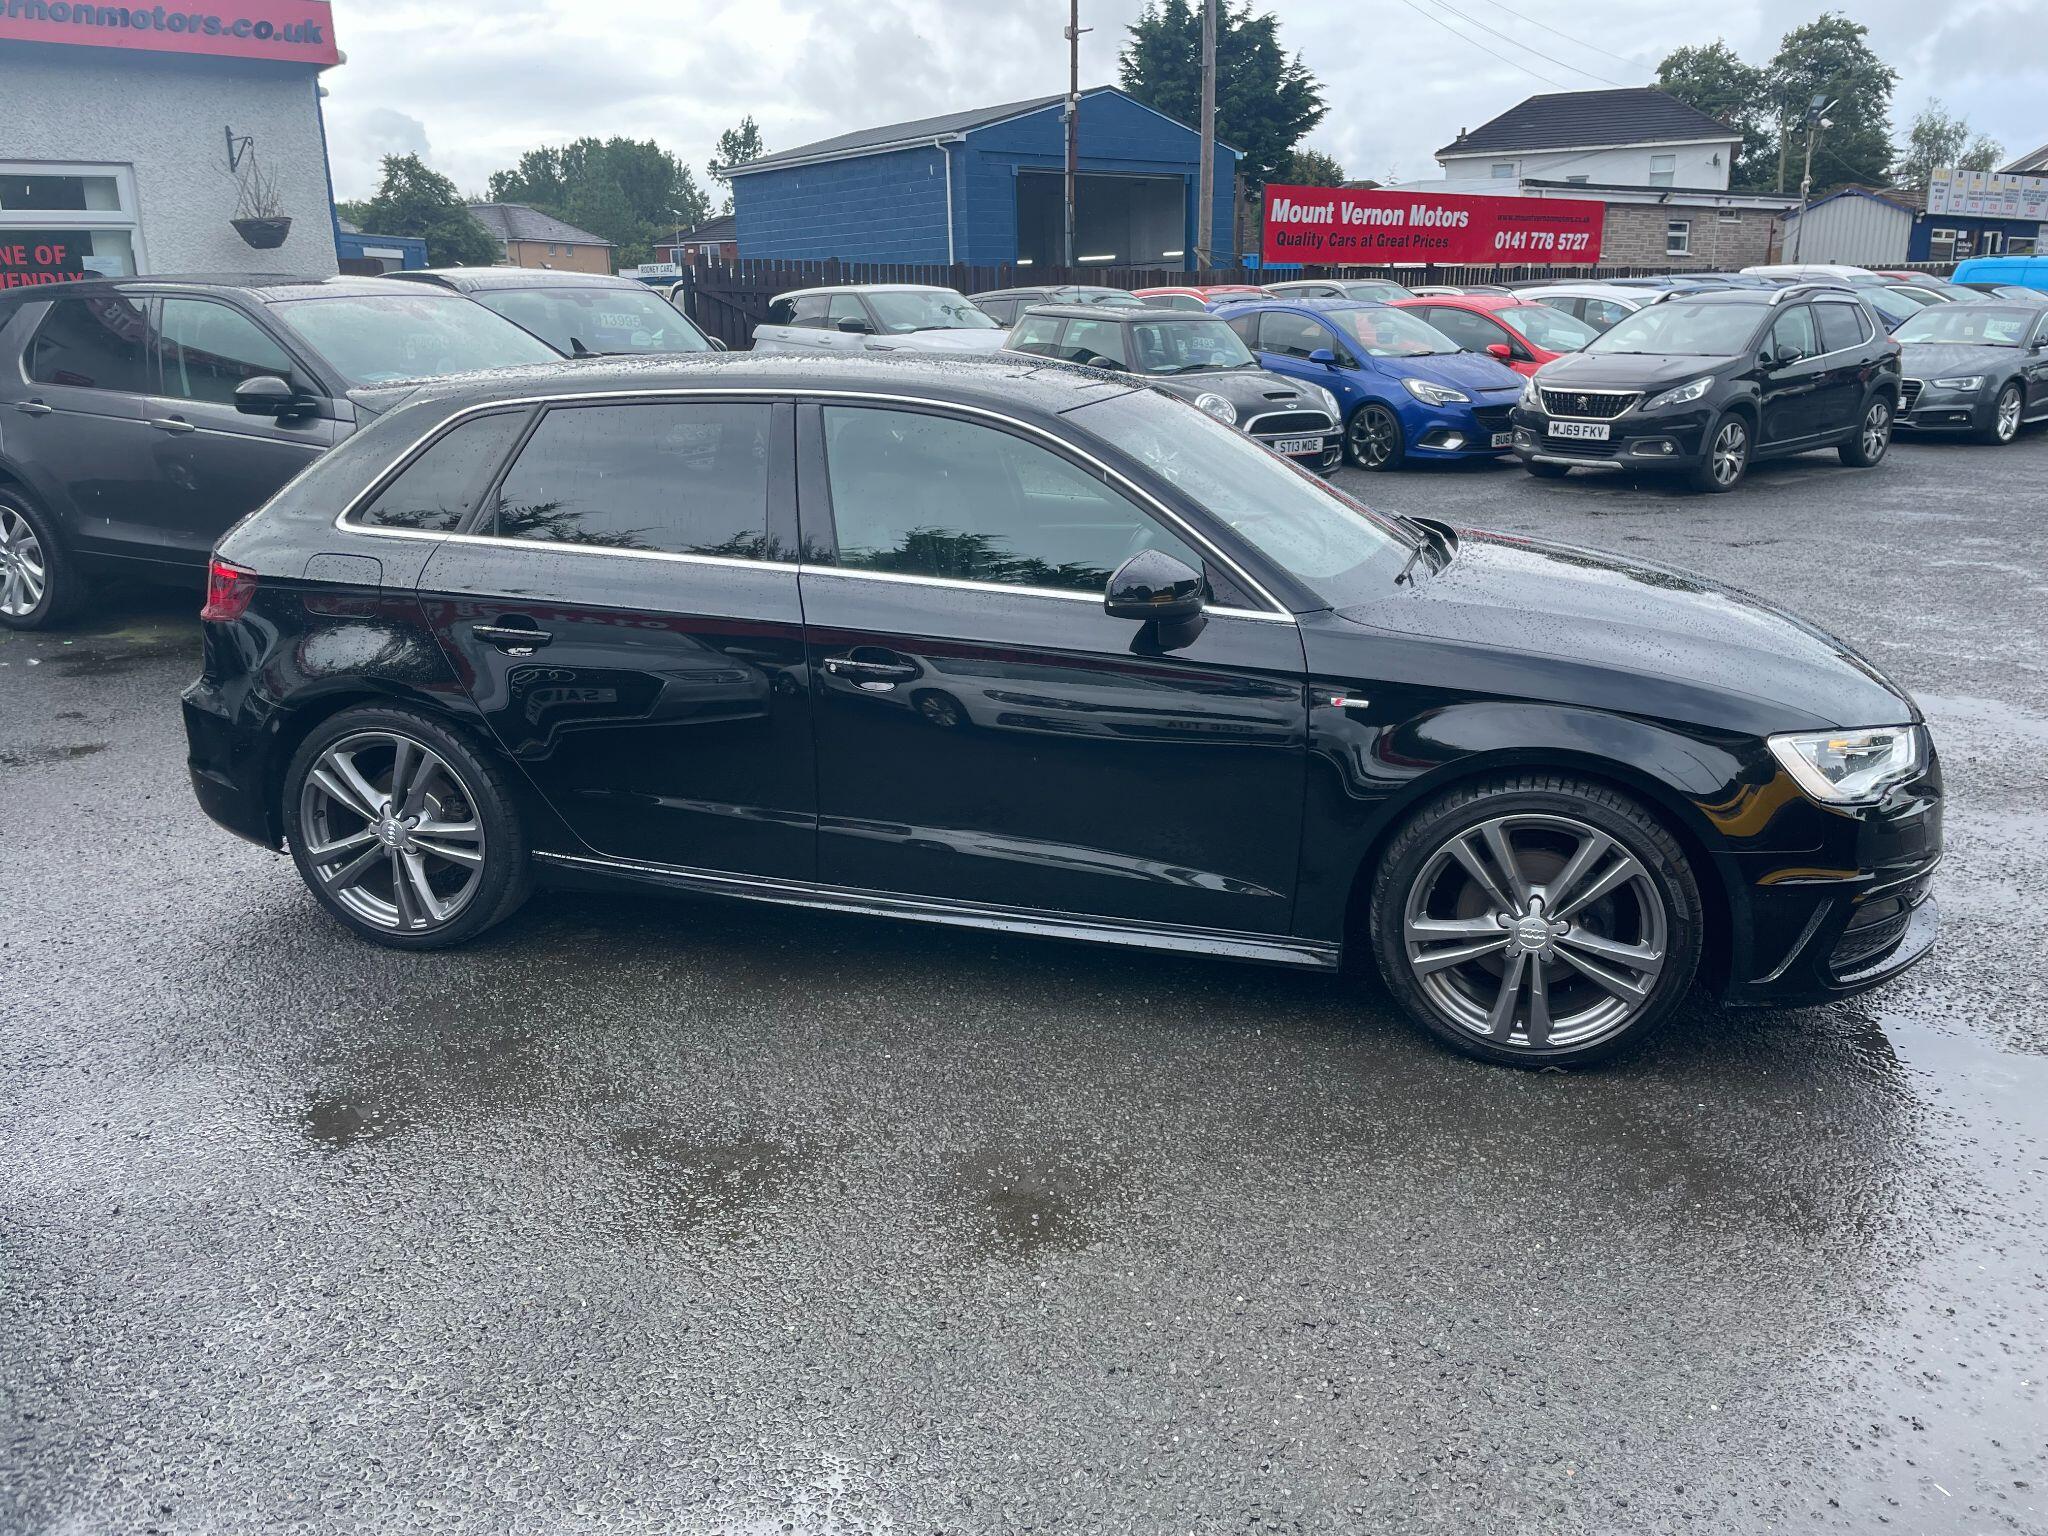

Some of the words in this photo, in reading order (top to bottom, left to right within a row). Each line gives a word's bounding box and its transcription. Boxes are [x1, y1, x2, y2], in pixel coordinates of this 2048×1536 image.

[0, 0, 324, 44] rnonmotors.co.uk
[1271, 198, 1334, 224] Mount
[1341, 201, 1404, 226] Vernon
[1409, 204, 1470, 228] Motors
[1276, 230, 1325, 250] Quality
[1328, 232, 1357, 248] Cars
[1360, 233, 1374, 248] at
[1376, 233, 1409, 248] Great
[1412, 234, 1449, 248] Prices
[1494, 231, 1527, 249] 0141
[1530, 231, 1555, 250] 778
[1557, 233, 1590, 250] 5727
[34, 245, 66, 265] OF
[1552, 423, 1580, 436] MJ69
[1582, 425, 1605, 438] FKV
[1280, 441, 1300, 453] ST13
